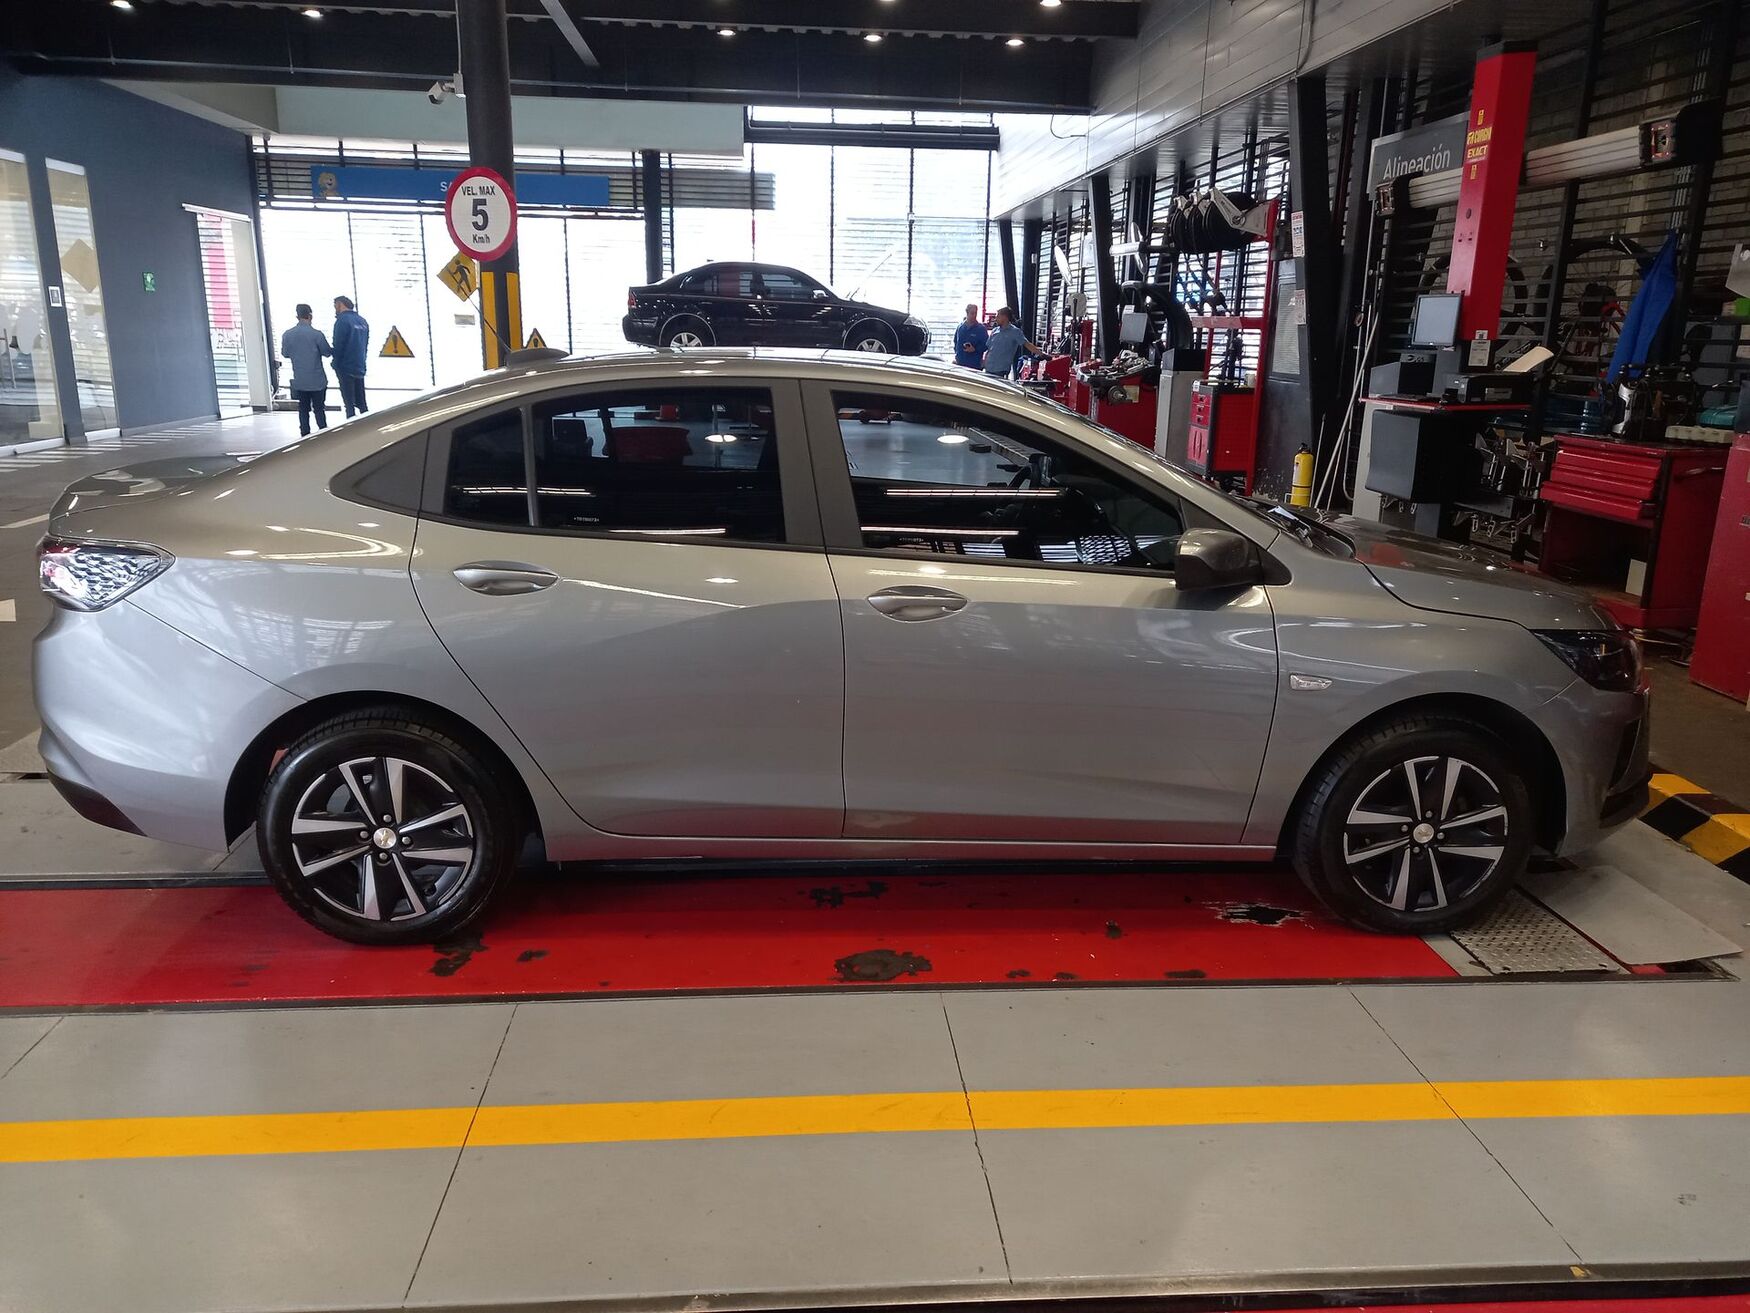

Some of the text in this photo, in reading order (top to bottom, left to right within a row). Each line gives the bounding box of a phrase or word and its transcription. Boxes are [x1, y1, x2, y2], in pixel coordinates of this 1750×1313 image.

[1383, 144, 1451, 180] Alineación
[1467, 144, 1489, 159] EXACT
[479, 185, 496, 196] MAX
[472, 198, 489, 231] 5
